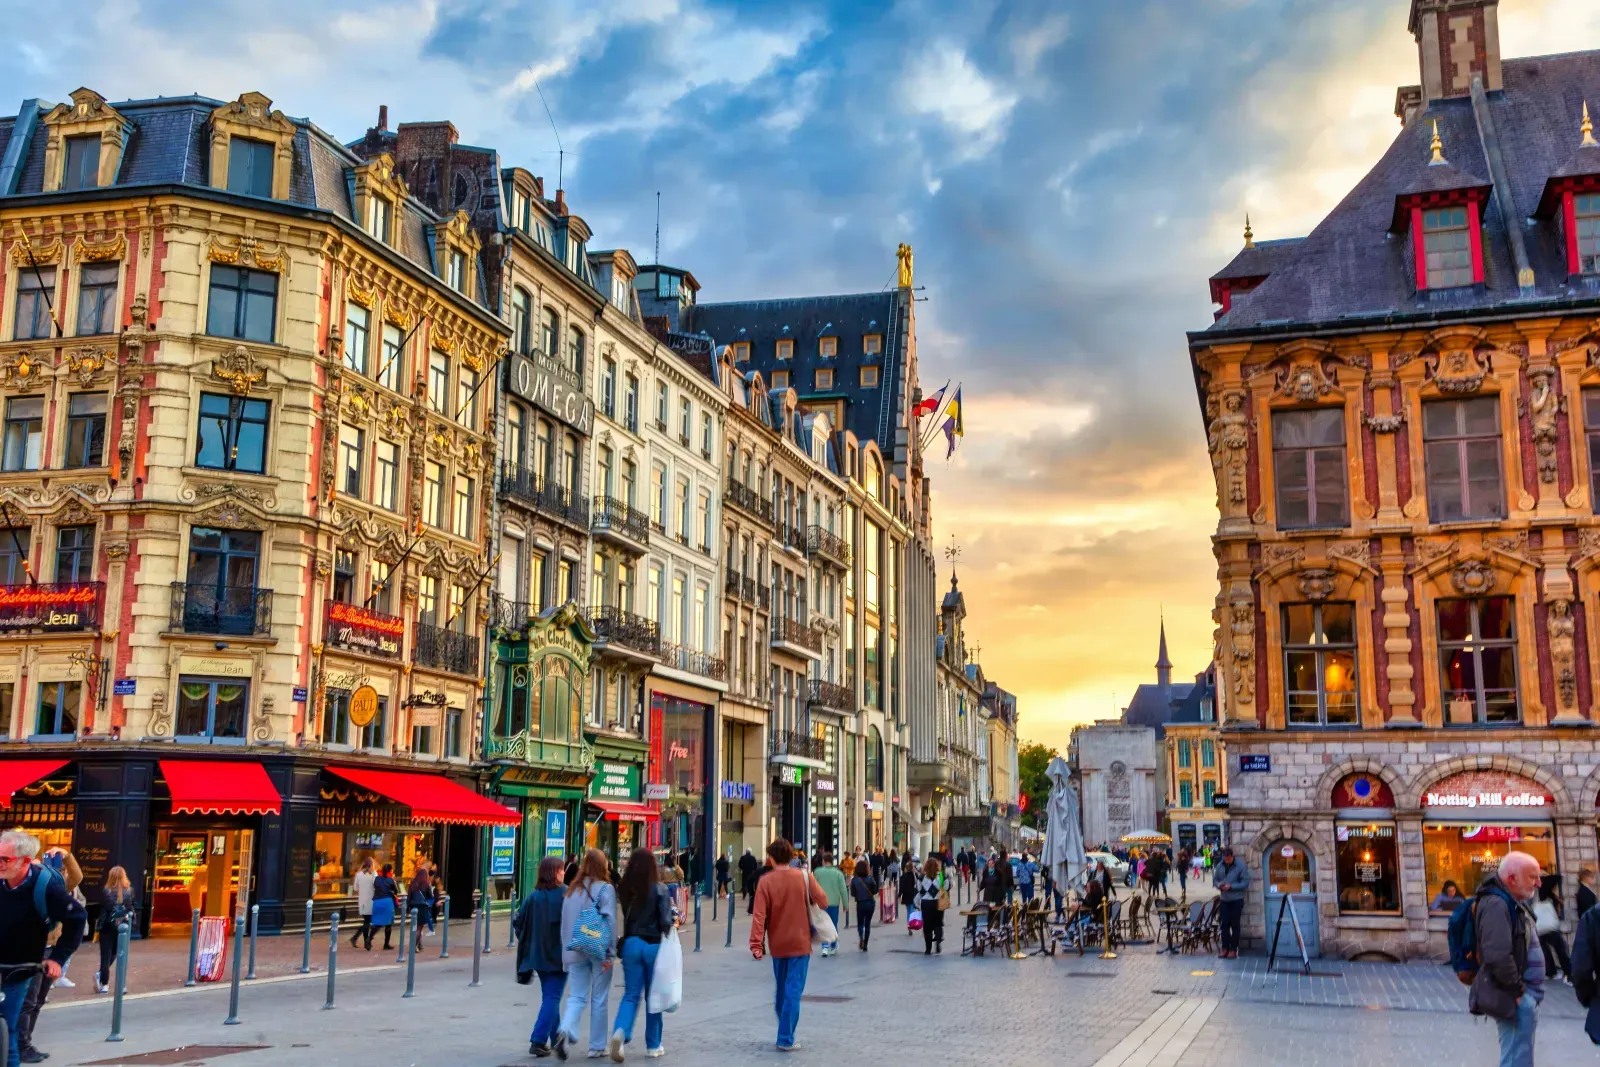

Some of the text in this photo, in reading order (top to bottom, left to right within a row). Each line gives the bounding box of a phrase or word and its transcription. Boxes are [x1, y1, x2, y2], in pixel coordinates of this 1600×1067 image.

[518, 359, 588, 431] OMEGA
[44, 610, 79, 626] Jean
[377, 636, 398, 653] Jean
[221, 665, 244, 675] Jean
[352, 700, 375, 713] PAUL
[669, 741, 689, 761] free
[817, 780, 835, 791] SEPHORA
[1427, 792, 1545, 808] Notting Hill coffee
[85, 822, 106, 832] PAUL
[1376, 828, 1392, 837] Hill
